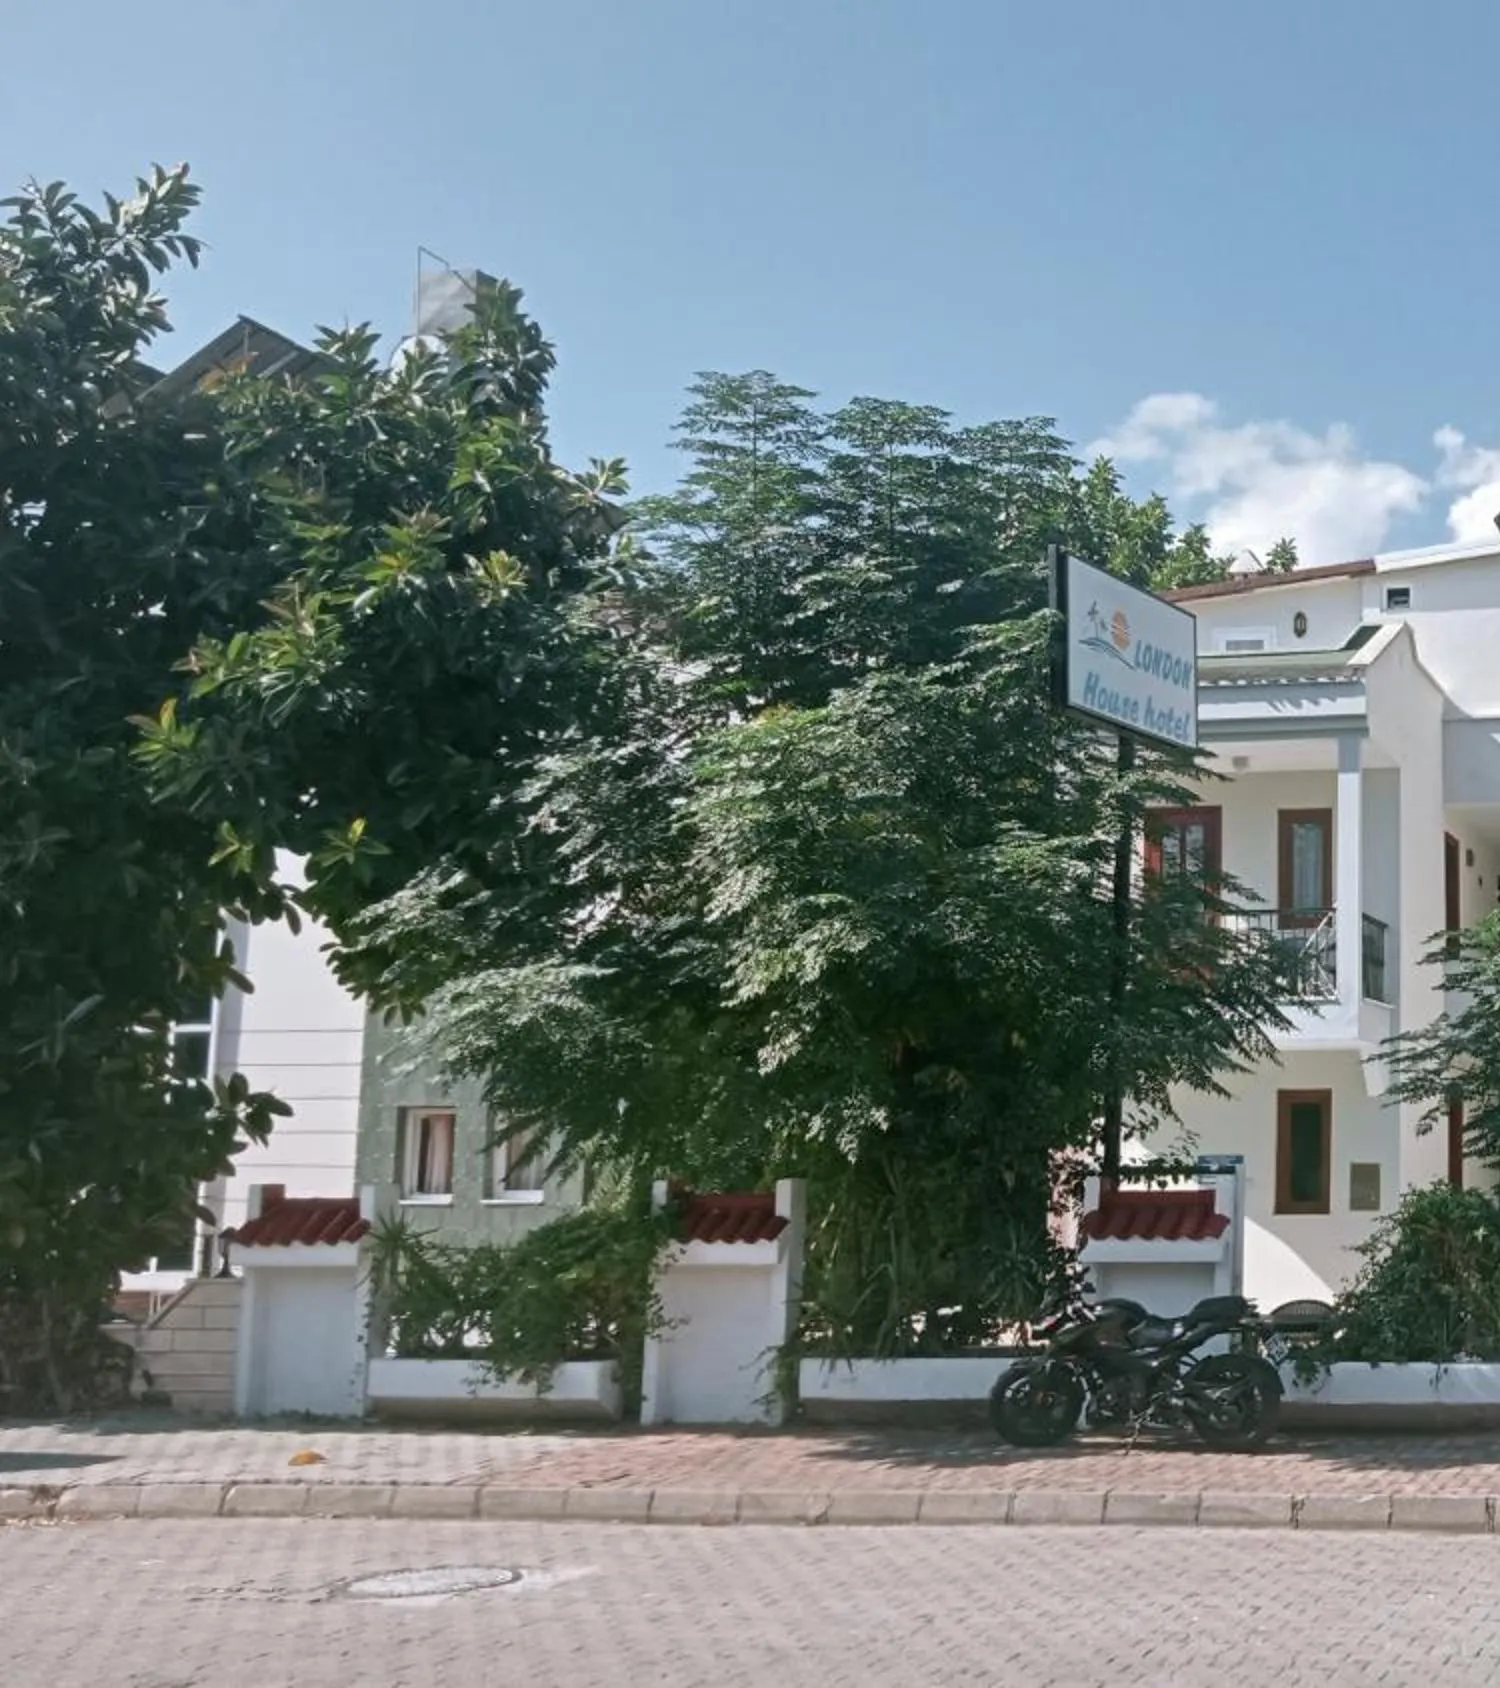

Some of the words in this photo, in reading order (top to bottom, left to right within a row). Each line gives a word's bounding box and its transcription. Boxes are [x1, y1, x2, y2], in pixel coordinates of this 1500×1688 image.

[1134, 640, 1192, 690] LONDON
[1083, 671, 1139, 722] House
[1143, 694, 1190, 741] hotel
